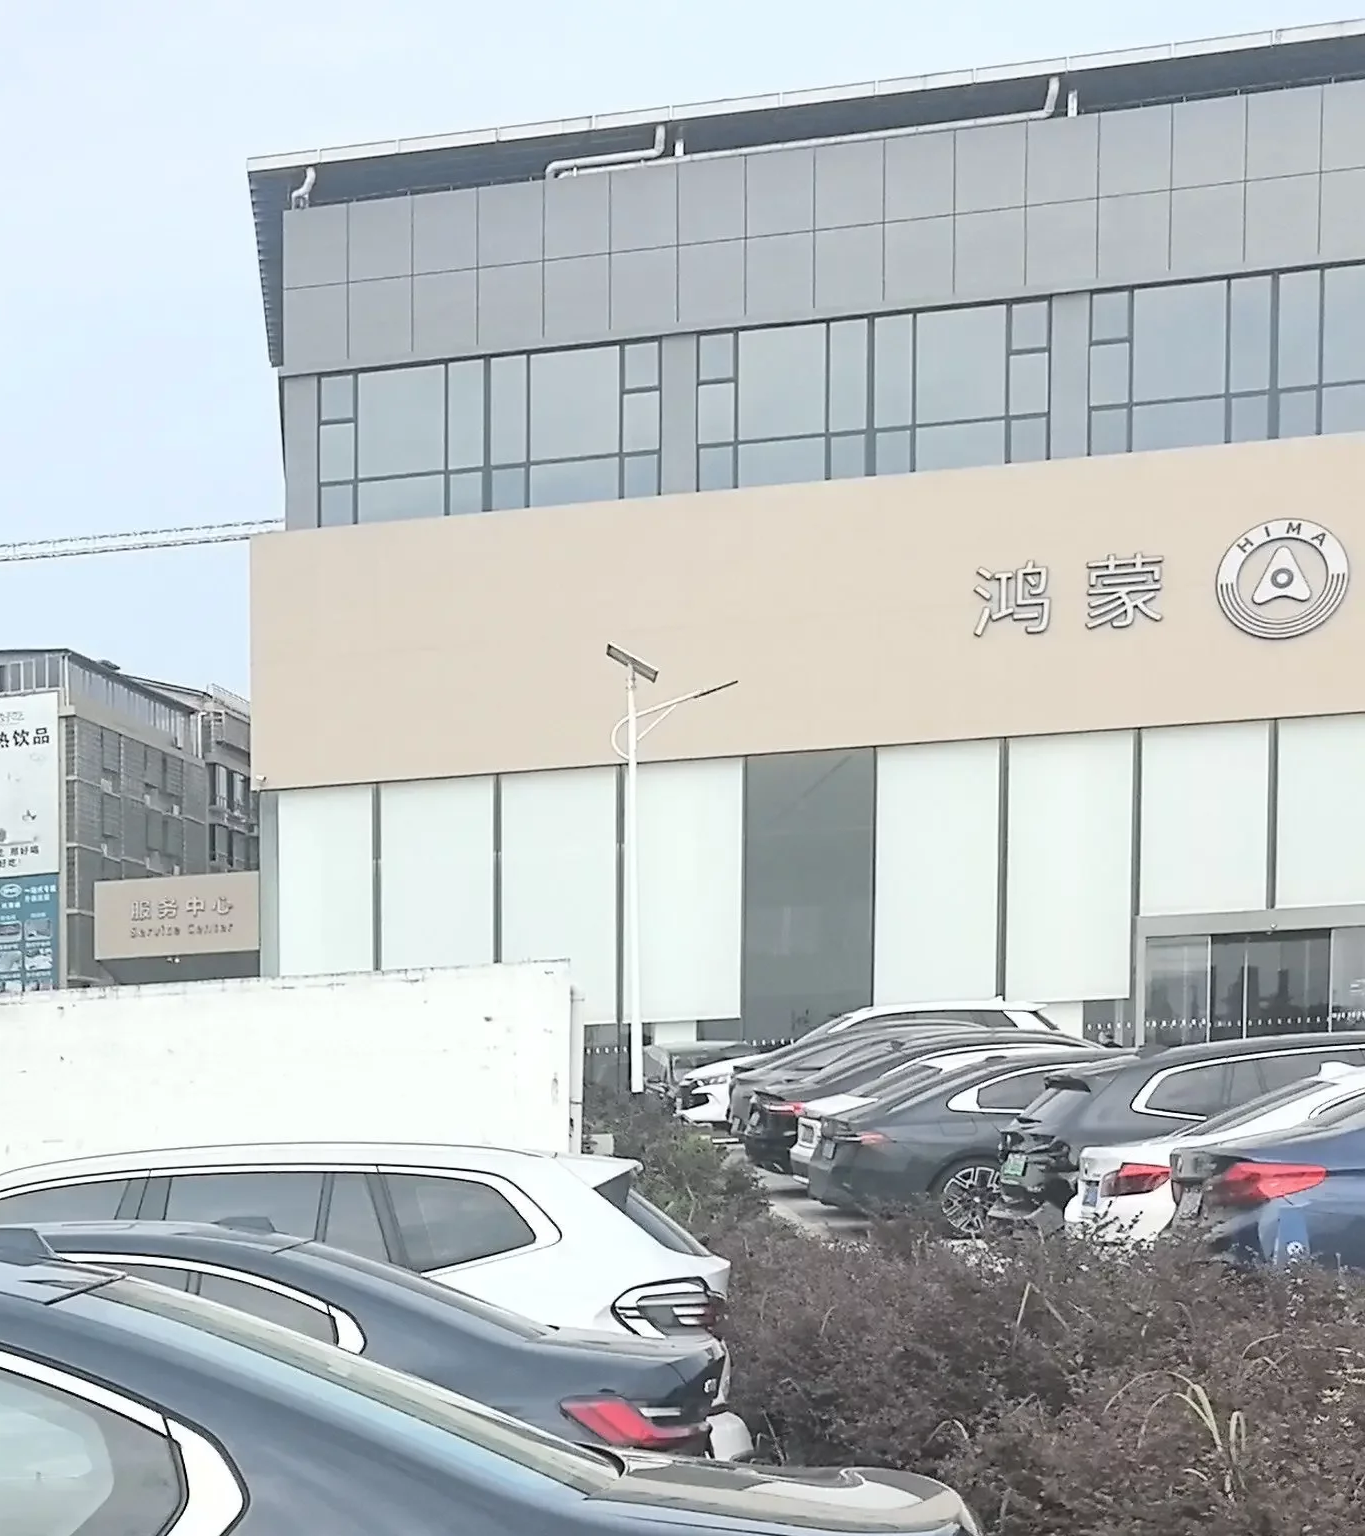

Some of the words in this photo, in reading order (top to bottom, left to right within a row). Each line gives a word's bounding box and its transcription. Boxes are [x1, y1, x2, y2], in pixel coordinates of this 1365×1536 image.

[1237, 522, 1326, 553] HIMA
[973, 551, 1164, 637] 鸿蒙
[131, 897, 233, 921] 服务中心
